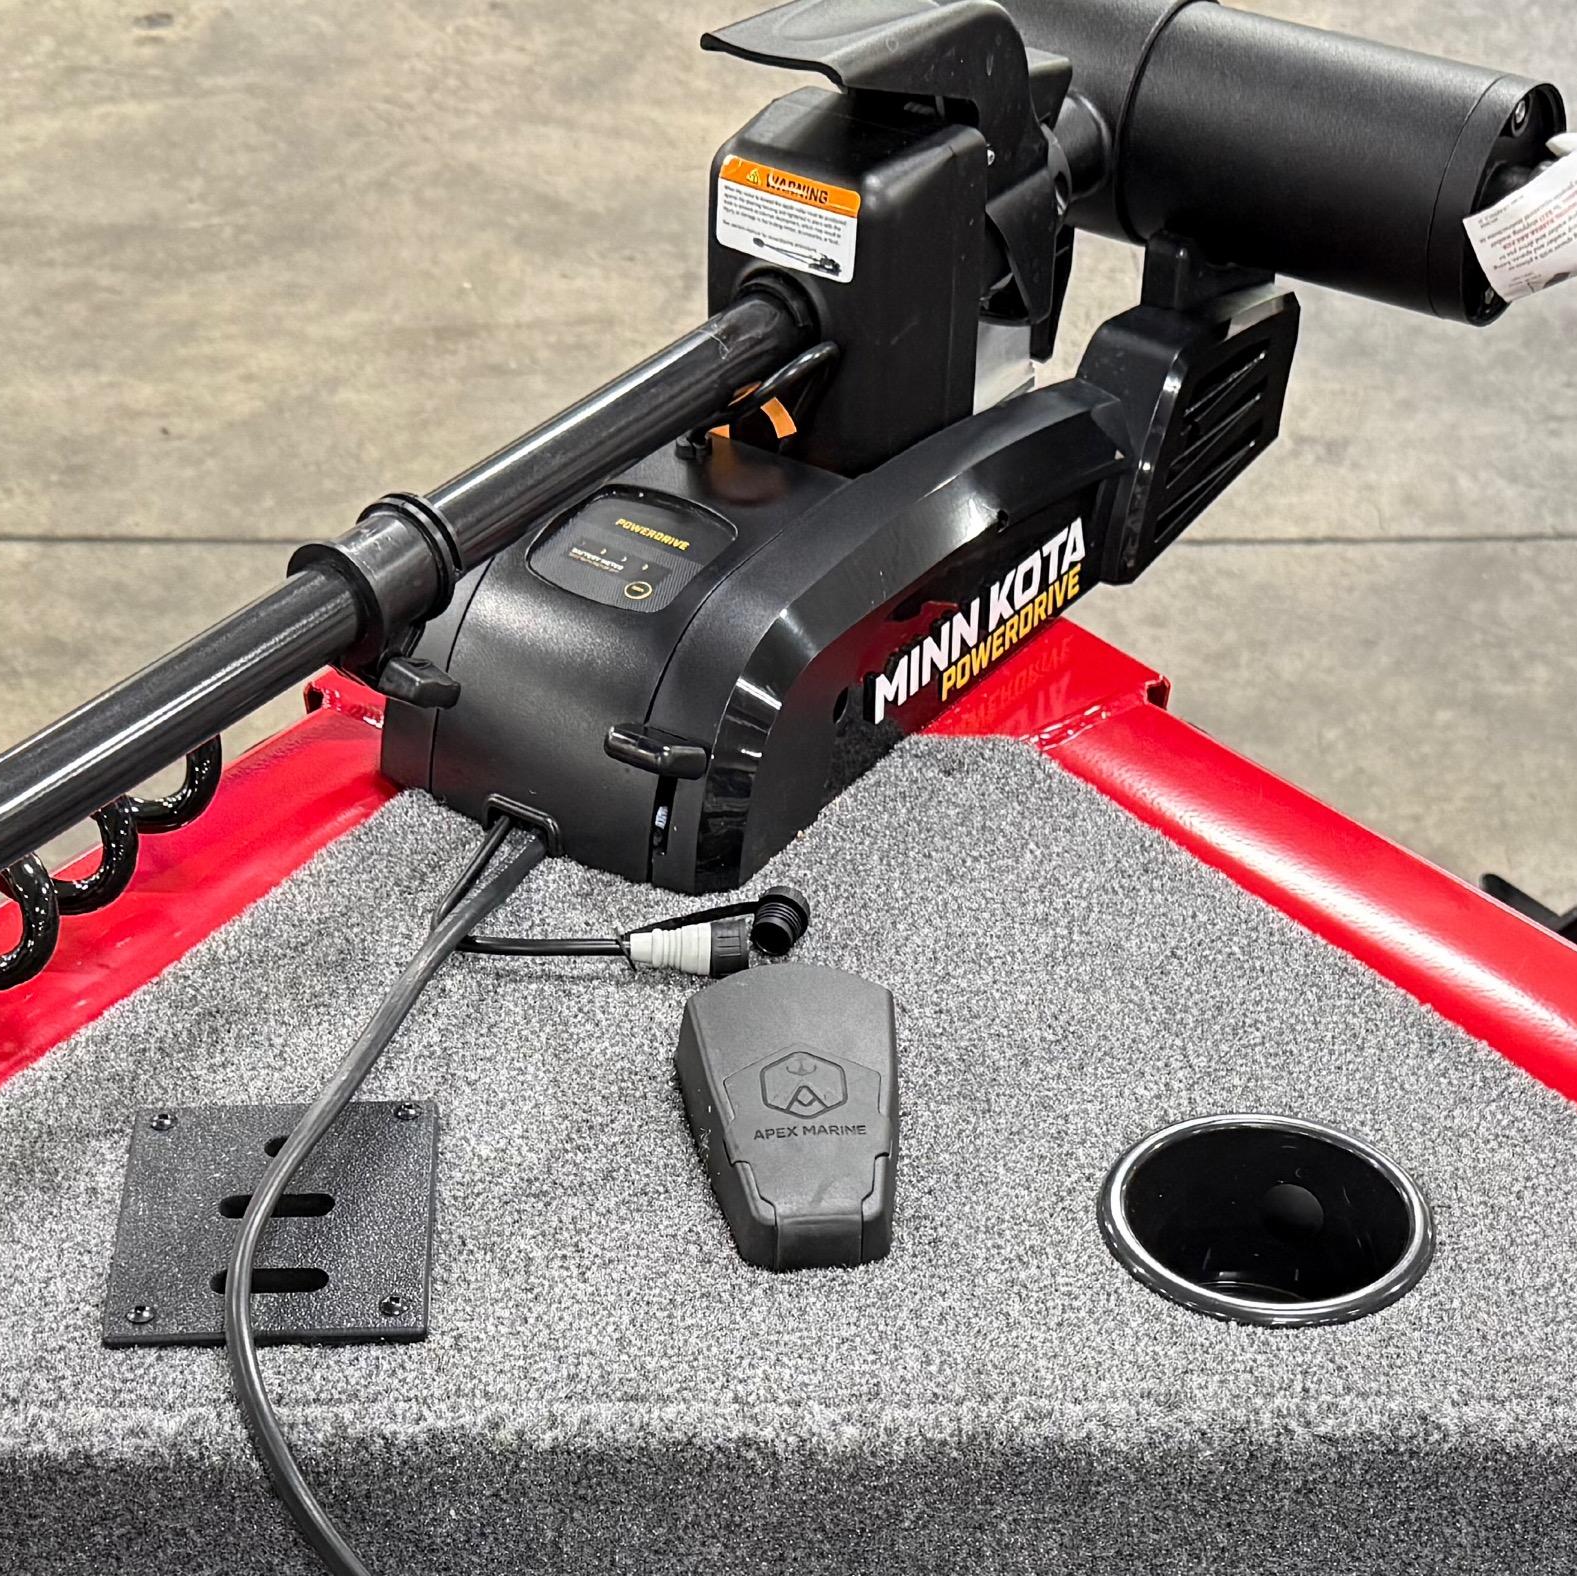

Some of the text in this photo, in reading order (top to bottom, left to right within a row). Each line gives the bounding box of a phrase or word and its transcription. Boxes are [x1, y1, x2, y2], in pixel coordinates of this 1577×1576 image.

[765, 173, 829, 205] WARNING
[615, 518, 690, 551] POWERDRIVE
[874, 516, 1086, 725] MINN KOTA
[941, 563, 1082, 702] POWERDRIVE
[753, 1124, 867, 1141] APEX MARINE
